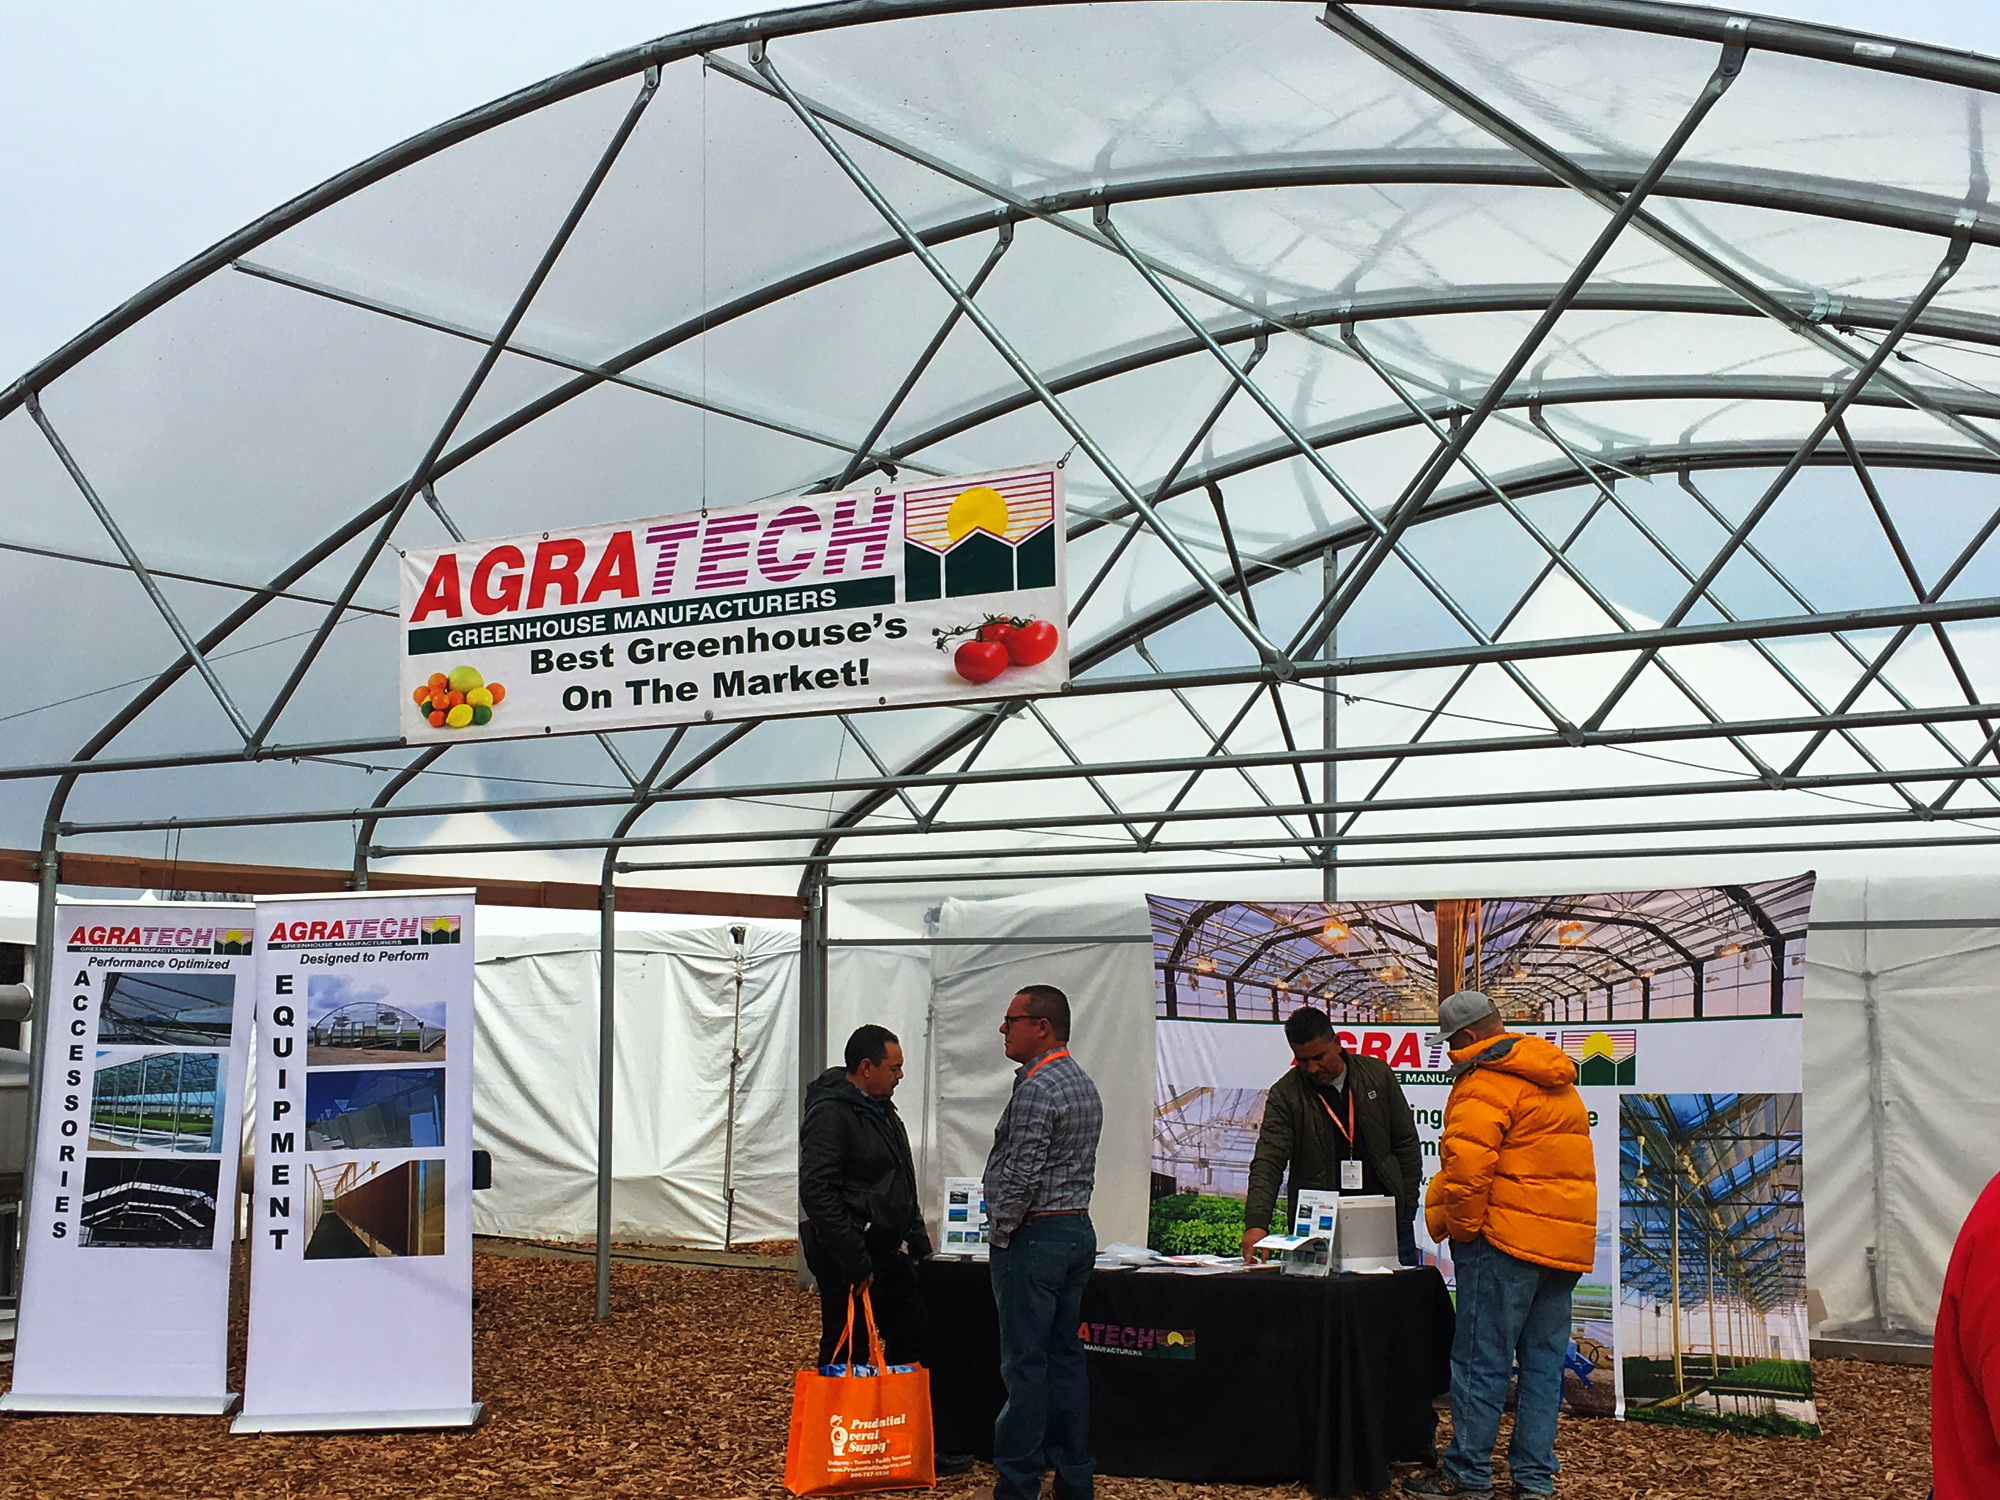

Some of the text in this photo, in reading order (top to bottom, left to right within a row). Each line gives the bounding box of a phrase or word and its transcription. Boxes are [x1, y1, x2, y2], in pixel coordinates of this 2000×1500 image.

[409, 494, 896, 622] AGRATECH
[446, 588, 837, 649] GREENHOUSE MANUFACTURERS
[530, 613, 908, 675] Best Greenhouse's
[563, 657, 871, 713] On The Market!
[68, 926, 213, 947] AGRATECH
[268, 917, 419, 942] AGRATECH
[131, 946, 196, 954] MANUFACTURERS
[299, 950, 430, 966] Designed to Perform
[88, 957, 231, 970] Performance Optimized
[269, 974, 294, 1251] EQUIPMENT
[1077, 1321, 1156, 1349] ATECH
[1083, 1344, 1143, 1356] MANUFACTURERS
